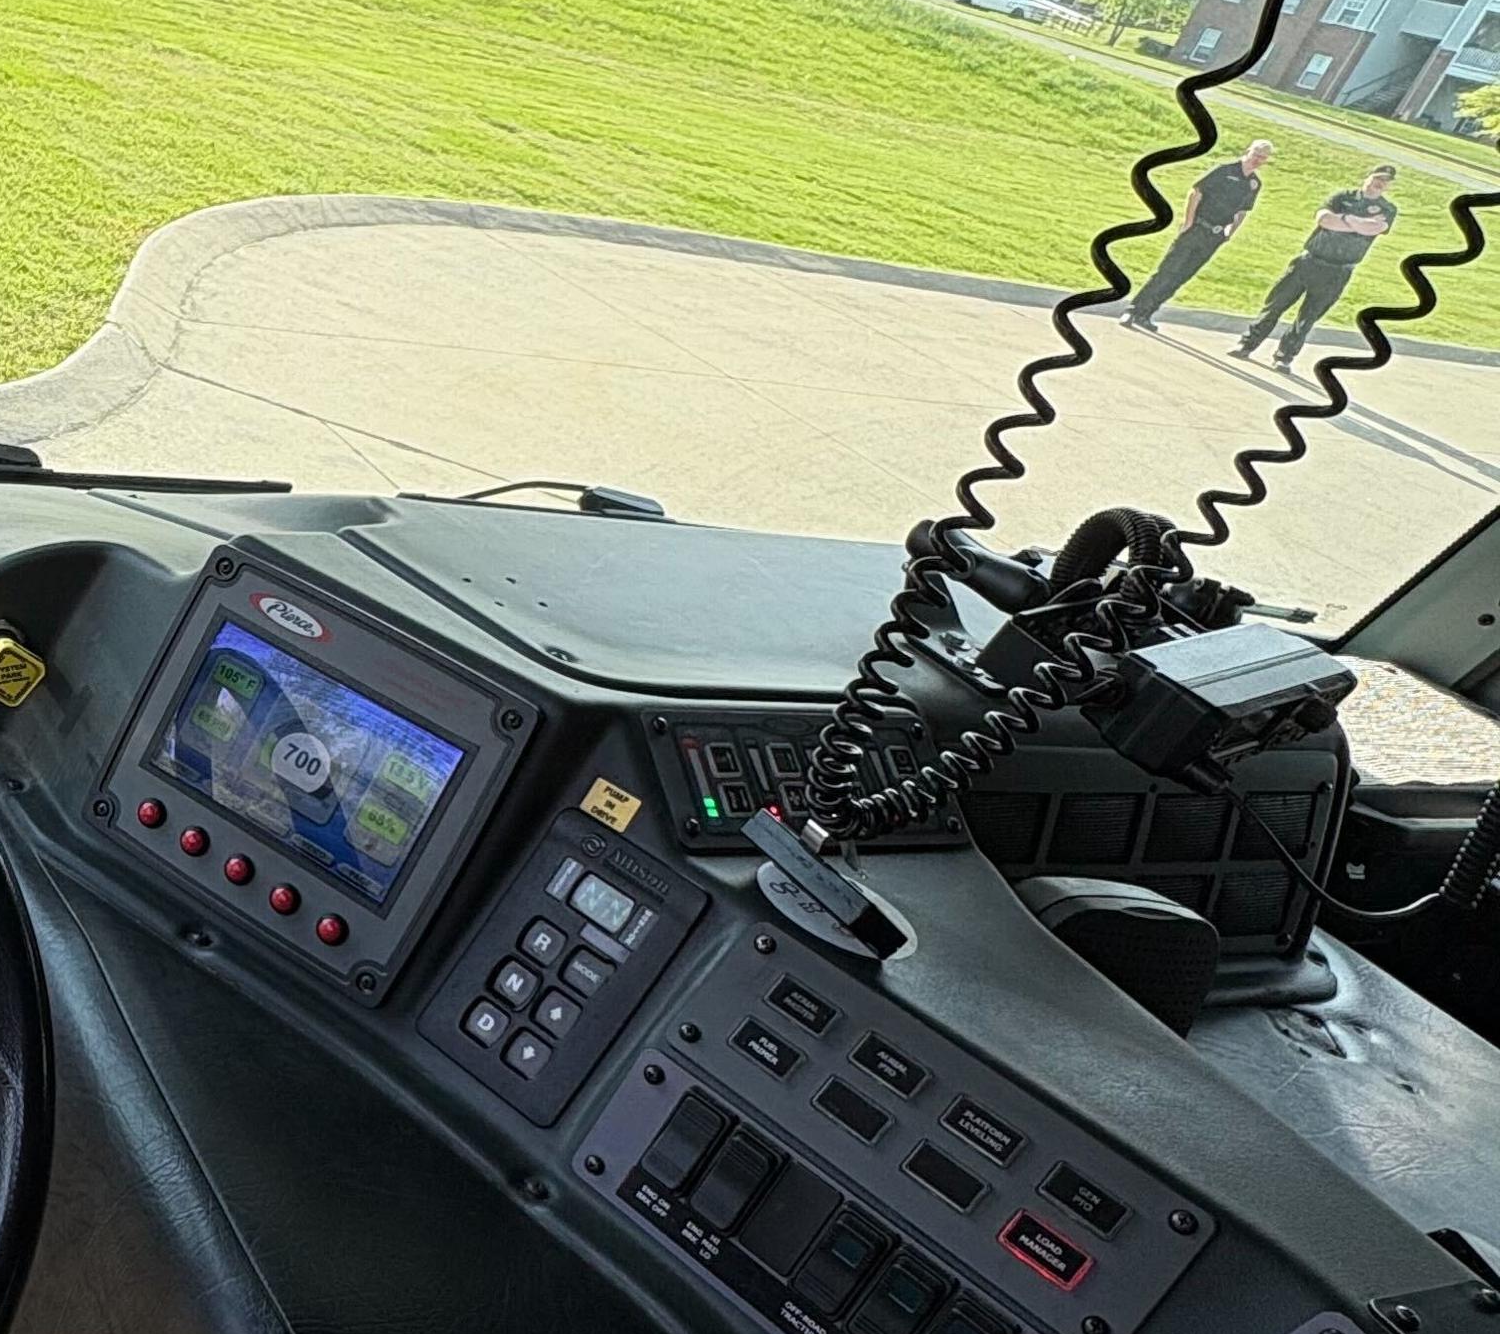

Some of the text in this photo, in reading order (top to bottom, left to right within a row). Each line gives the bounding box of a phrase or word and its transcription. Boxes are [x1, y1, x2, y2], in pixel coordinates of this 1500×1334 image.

[267, 601, 316, 636] Pierce
[283, 742, 322, 777] 700
[604, 786, 630, 804] PUMP
[604, 799, 616, 811] IN
[590, 805, 618, 825] DRIVE
[611, 847, 670, 895] Allison
[533, 932, 552, 952] R
[505, 972, 524, 993] N
[571, 960, 601, 984] MODE
[476, 1013, 495, 1032] D
[758, 1035, 779, 1054] FUEL
[957, 1118, 1004, 1153] LEVELING
[963, 1109, 1012, 1146] PLATFORM
[1072, 1195, 1094, 1213] PTO
[1078, 1186, 1102, 1206] GEN
[1018, 1234, 1067, 1272] MANAGER
[1035, 1232, 1064, 1256] LOAD
